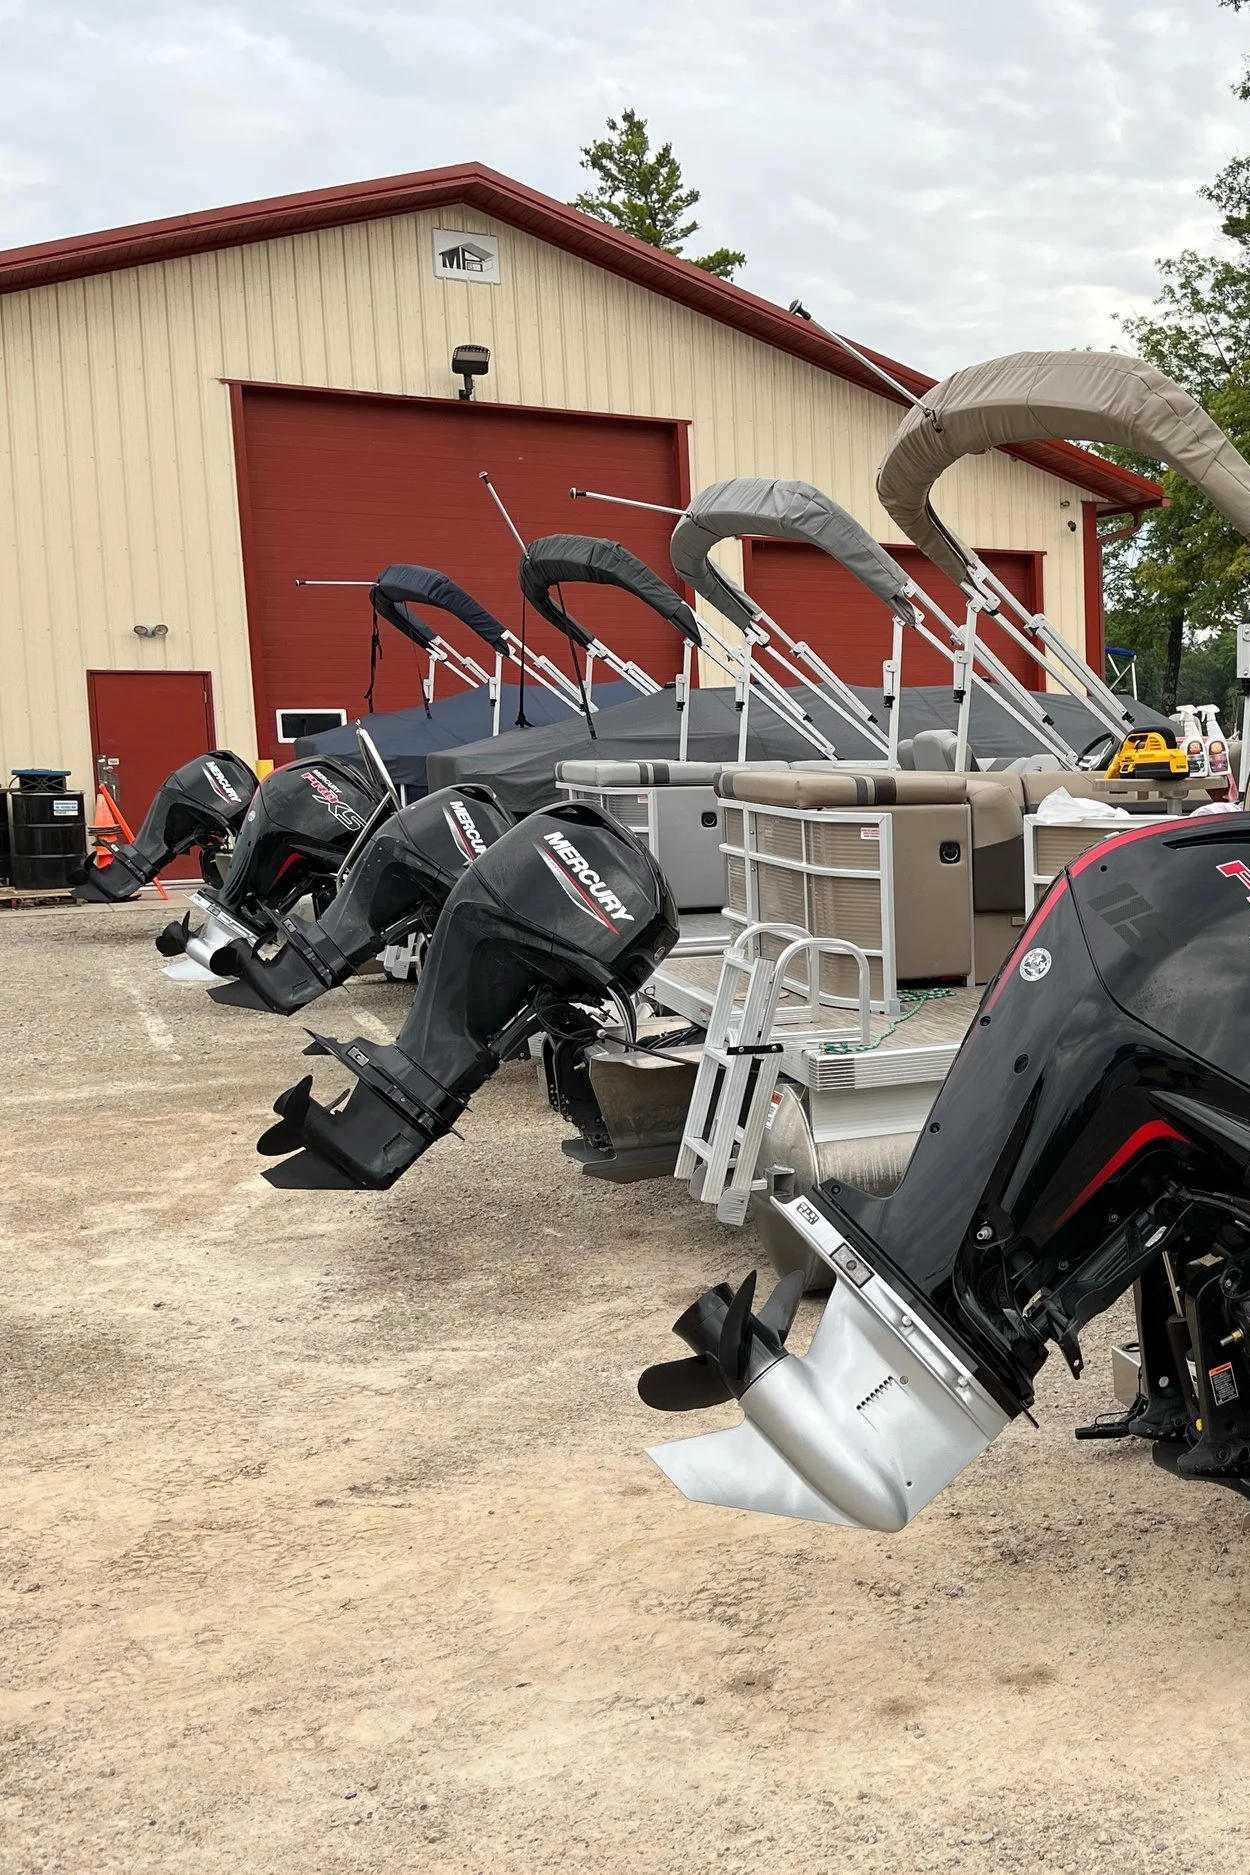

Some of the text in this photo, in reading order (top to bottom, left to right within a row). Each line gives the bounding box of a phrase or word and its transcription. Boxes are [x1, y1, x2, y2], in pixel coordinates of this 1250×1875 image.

[205, 761, 242, 803] MERCURY
[301, 772, 339, 804] PRO
[312, 769, 343, 793] MERCURY
[312, 794, 367, 831] XS
[543, 831, 635, 920] MERCURY
